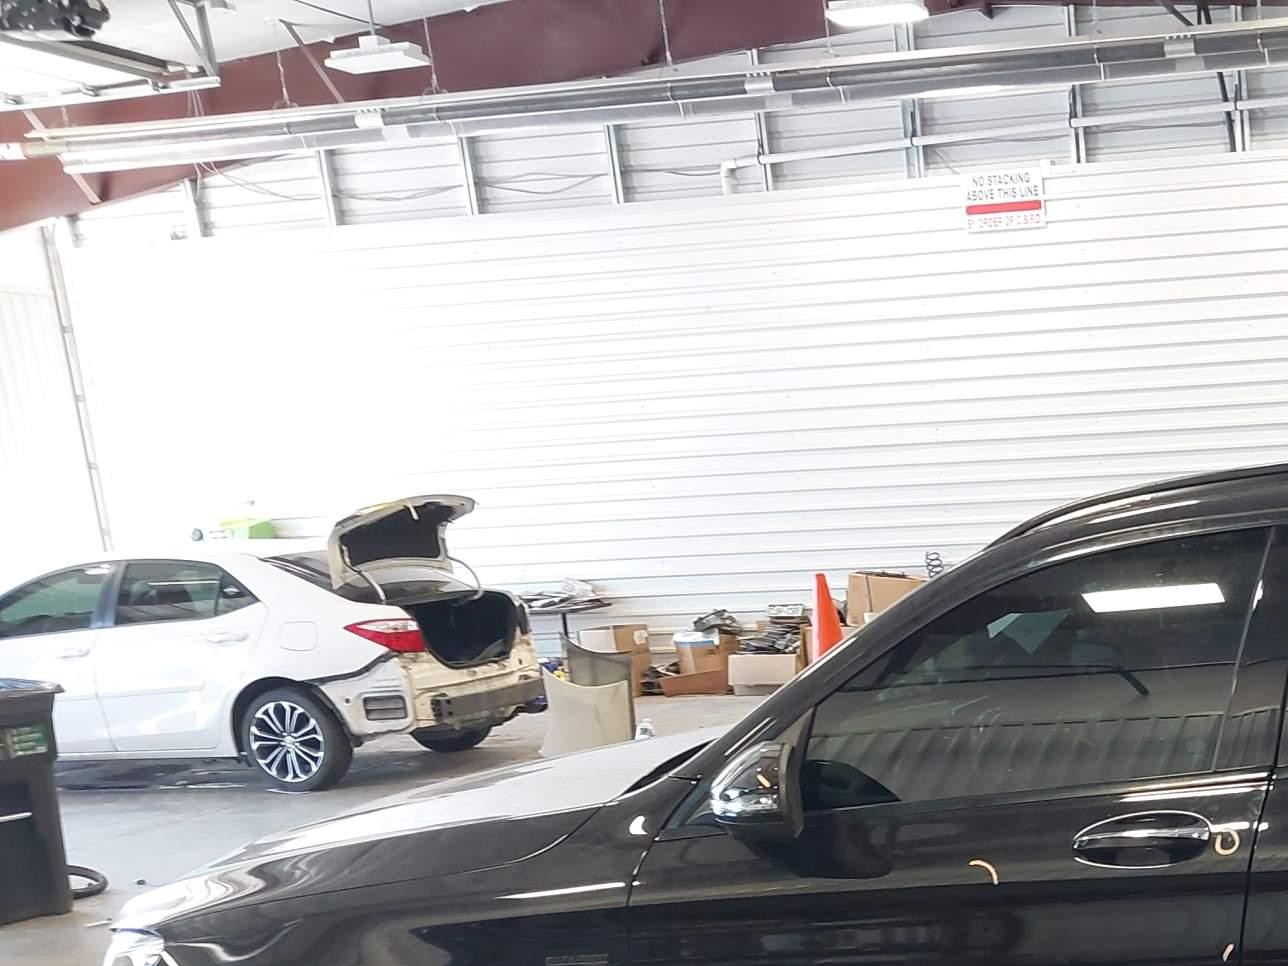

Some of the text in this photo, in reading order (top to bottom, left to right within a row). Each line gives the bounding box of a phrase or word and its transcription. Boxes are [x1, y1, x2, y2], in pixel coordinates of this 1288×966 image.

[972, 172, 1031, 187] NO STACKING
[967, 184, 1039, 201] ABOVE THIS LINE
